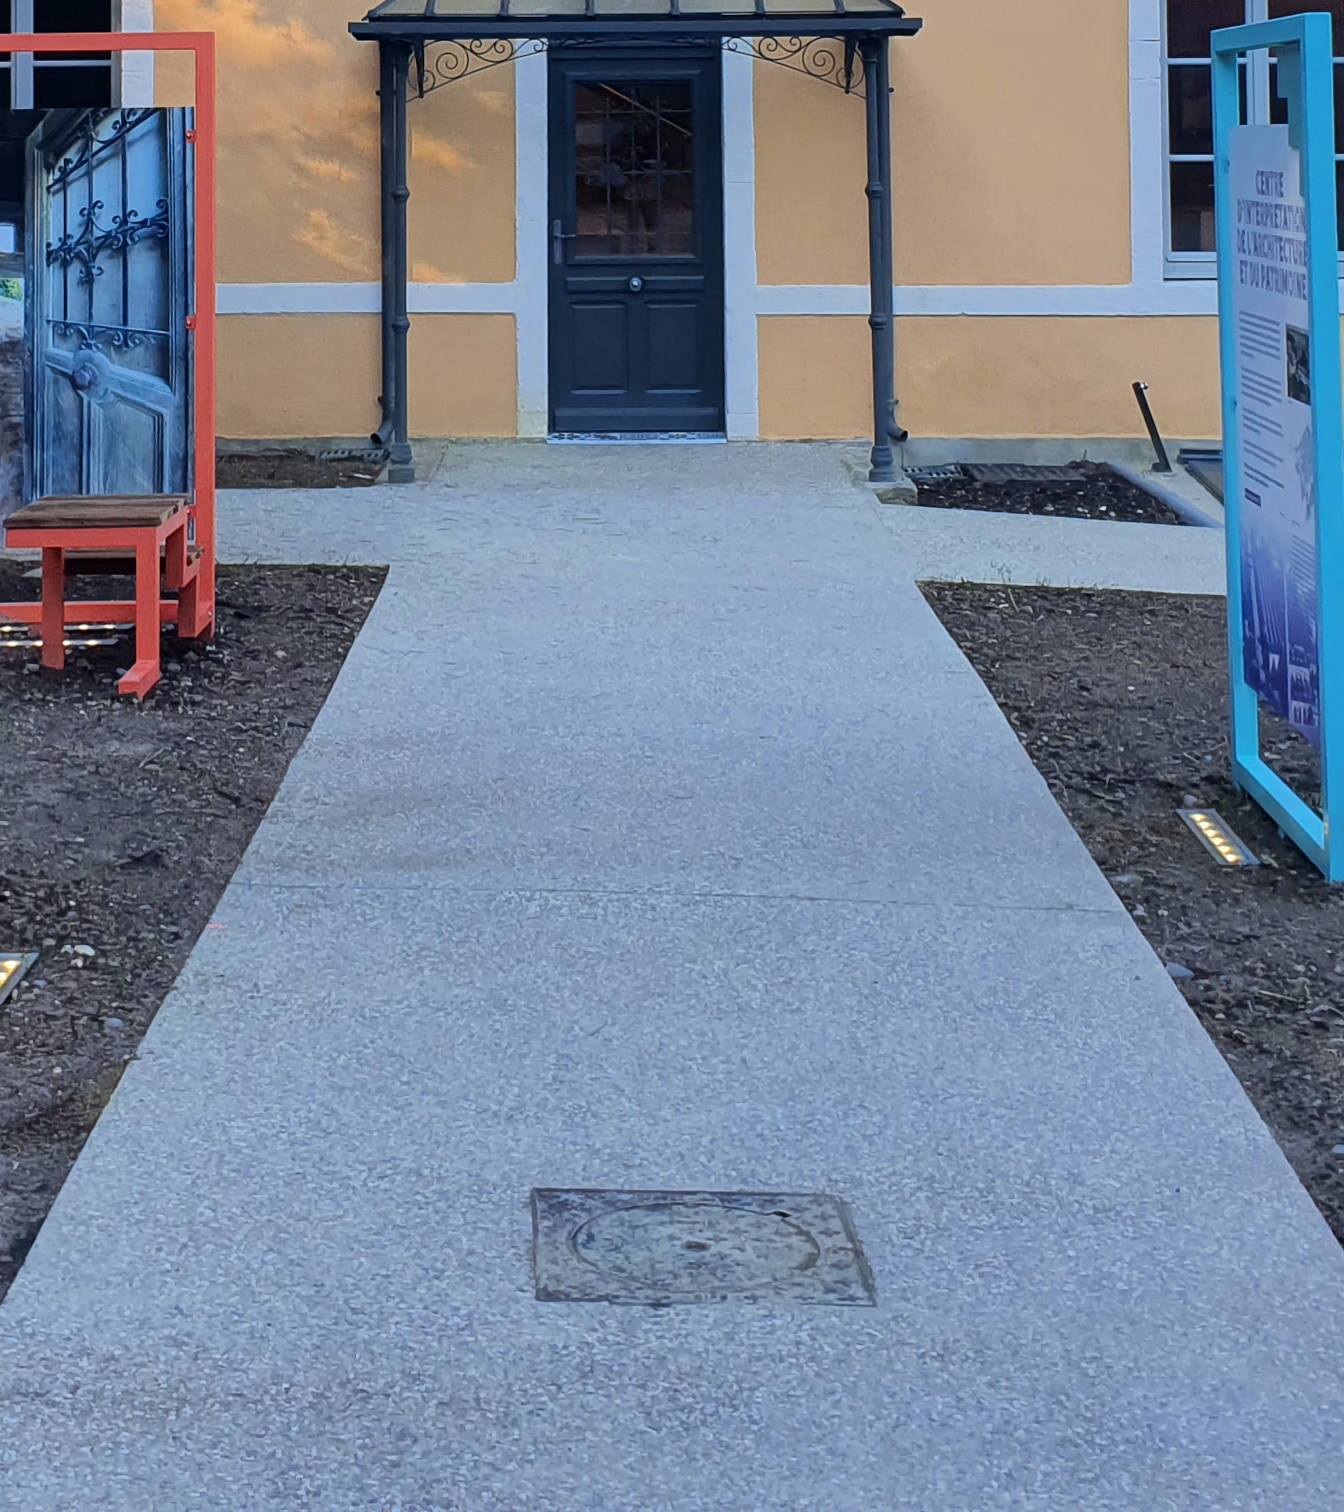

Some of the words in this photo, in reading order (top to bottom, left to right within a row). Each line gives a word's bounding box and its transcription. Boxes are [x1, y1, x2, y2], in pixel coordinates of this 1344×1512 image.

[1256, 170, 1284, 197] CENTRE
[1237, 228, 1246, 254] DE
[1239, 259, 1248, 285] ET
[1249, 262, 1260, 287] DU
[1260, 264, 1307, 300] PATRIMOINE
